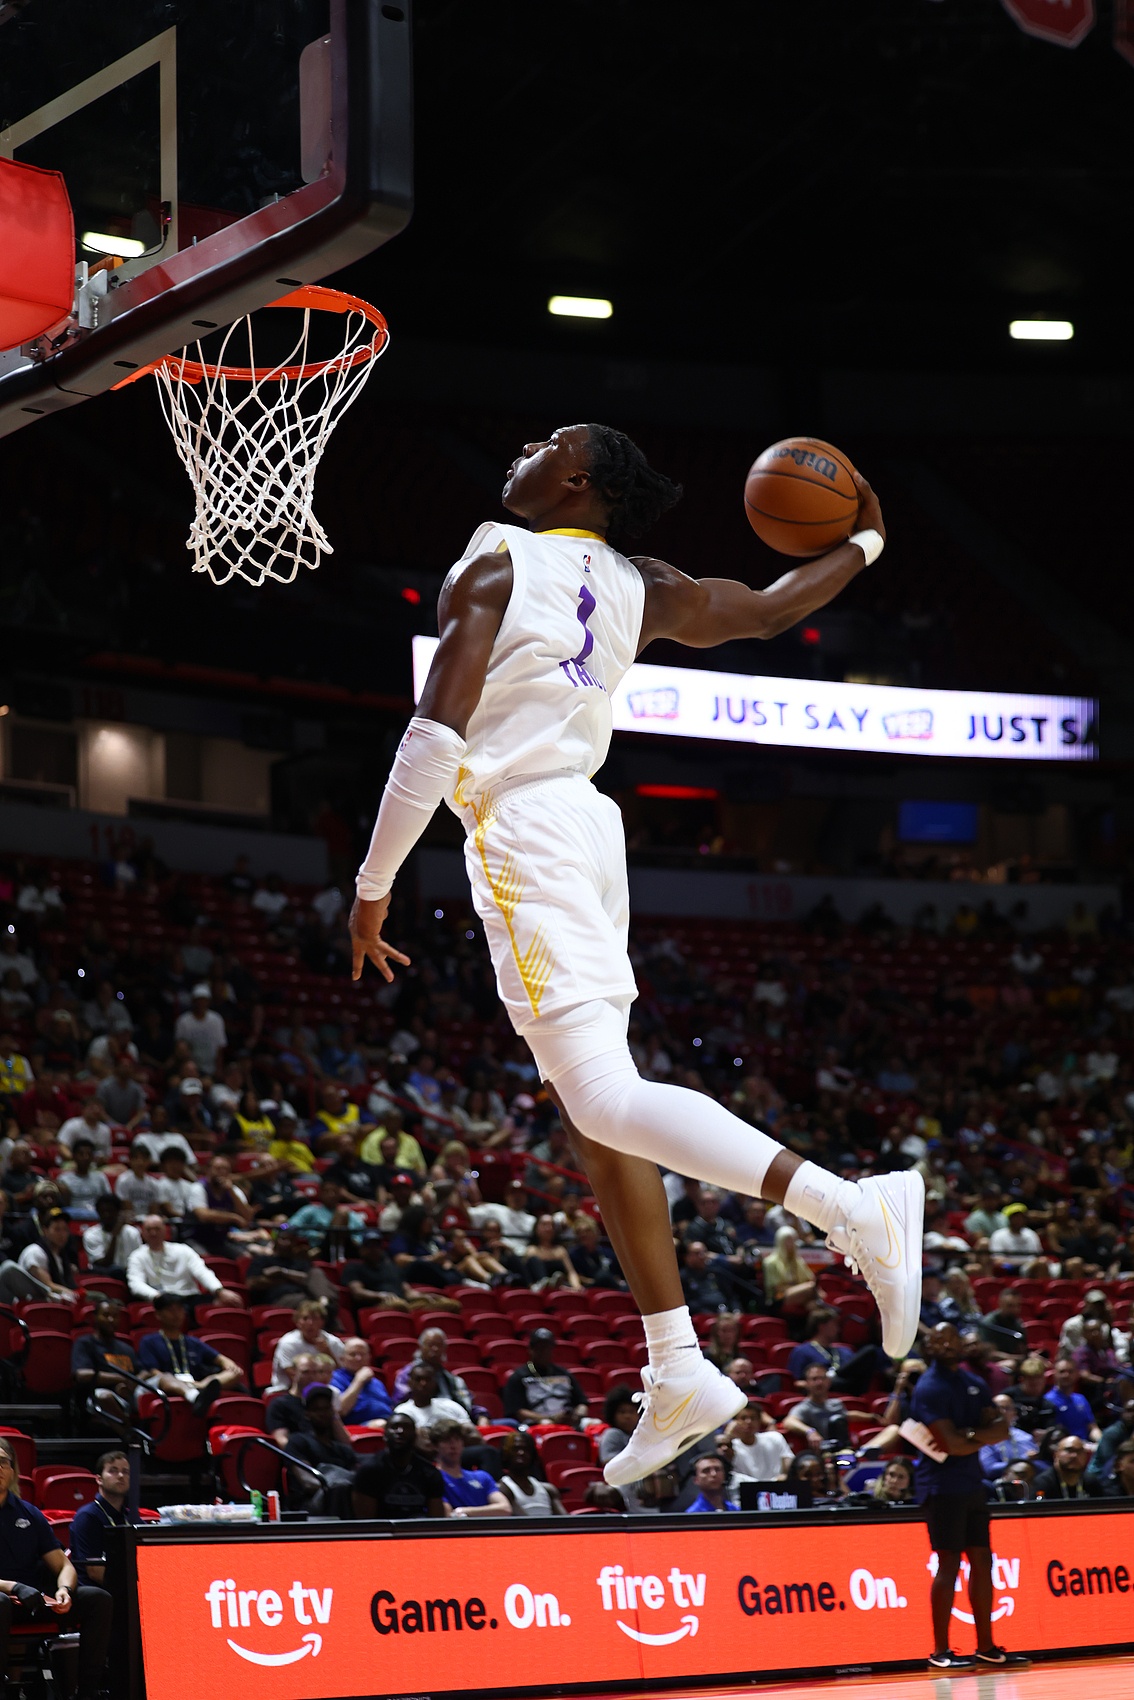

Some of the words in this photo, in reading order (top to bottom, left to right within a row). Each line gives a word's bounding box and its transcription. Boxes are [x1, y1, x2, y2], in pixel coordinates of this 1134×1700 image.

[712, 696, 788, 726] JUST
[805, 704, 869, 733] SAY
[967, 714, 1047, 743] JUST
[204, 1578, 284, 1629] fire
[288, 1580, 334, 1626] tv
[370, 1589, 498, 1635] Game.
[503, 1583, 572, 1629] On.
[596, 1564, 666, 1611] fire
[667, 1567, 707, 1609] tv
[738, 1575, 845, 1616] Game.
[849, 1568, 908, 1611] On.
